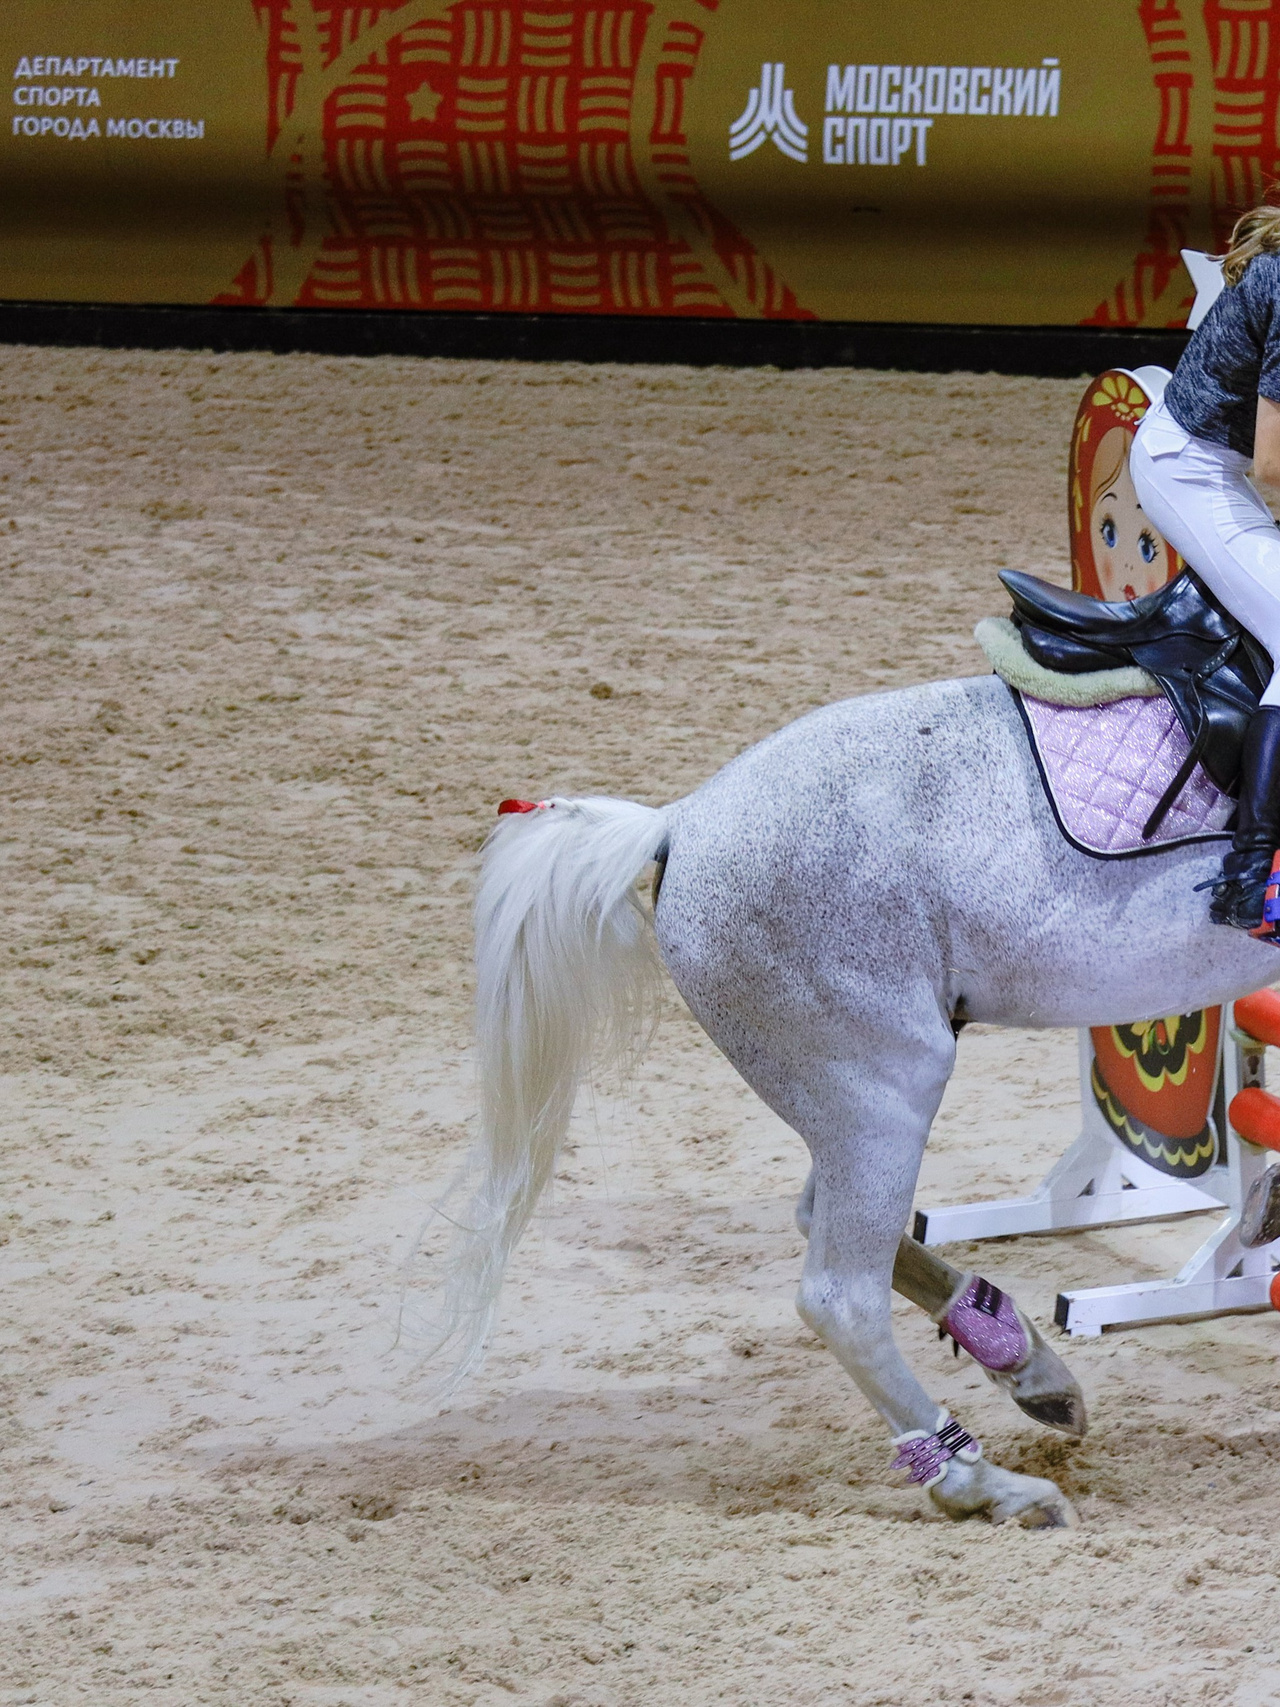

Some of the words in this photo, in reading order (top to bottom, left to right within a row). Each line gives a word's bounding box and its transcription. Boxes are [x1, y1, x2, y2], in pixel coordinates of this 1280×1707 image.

[13, 56, 180, 79] ДЕПАРТАМЕНТ
[12, 86, 102, 107] СПОРТА
[825, 57, 1062, 117] МОСКОВСКИЙ
[12, 115, 101, 140] ГОРОДА
[105, 118, 206, 140] МОСКВЫ
[822, 117, 934, 166] СПОРТ
